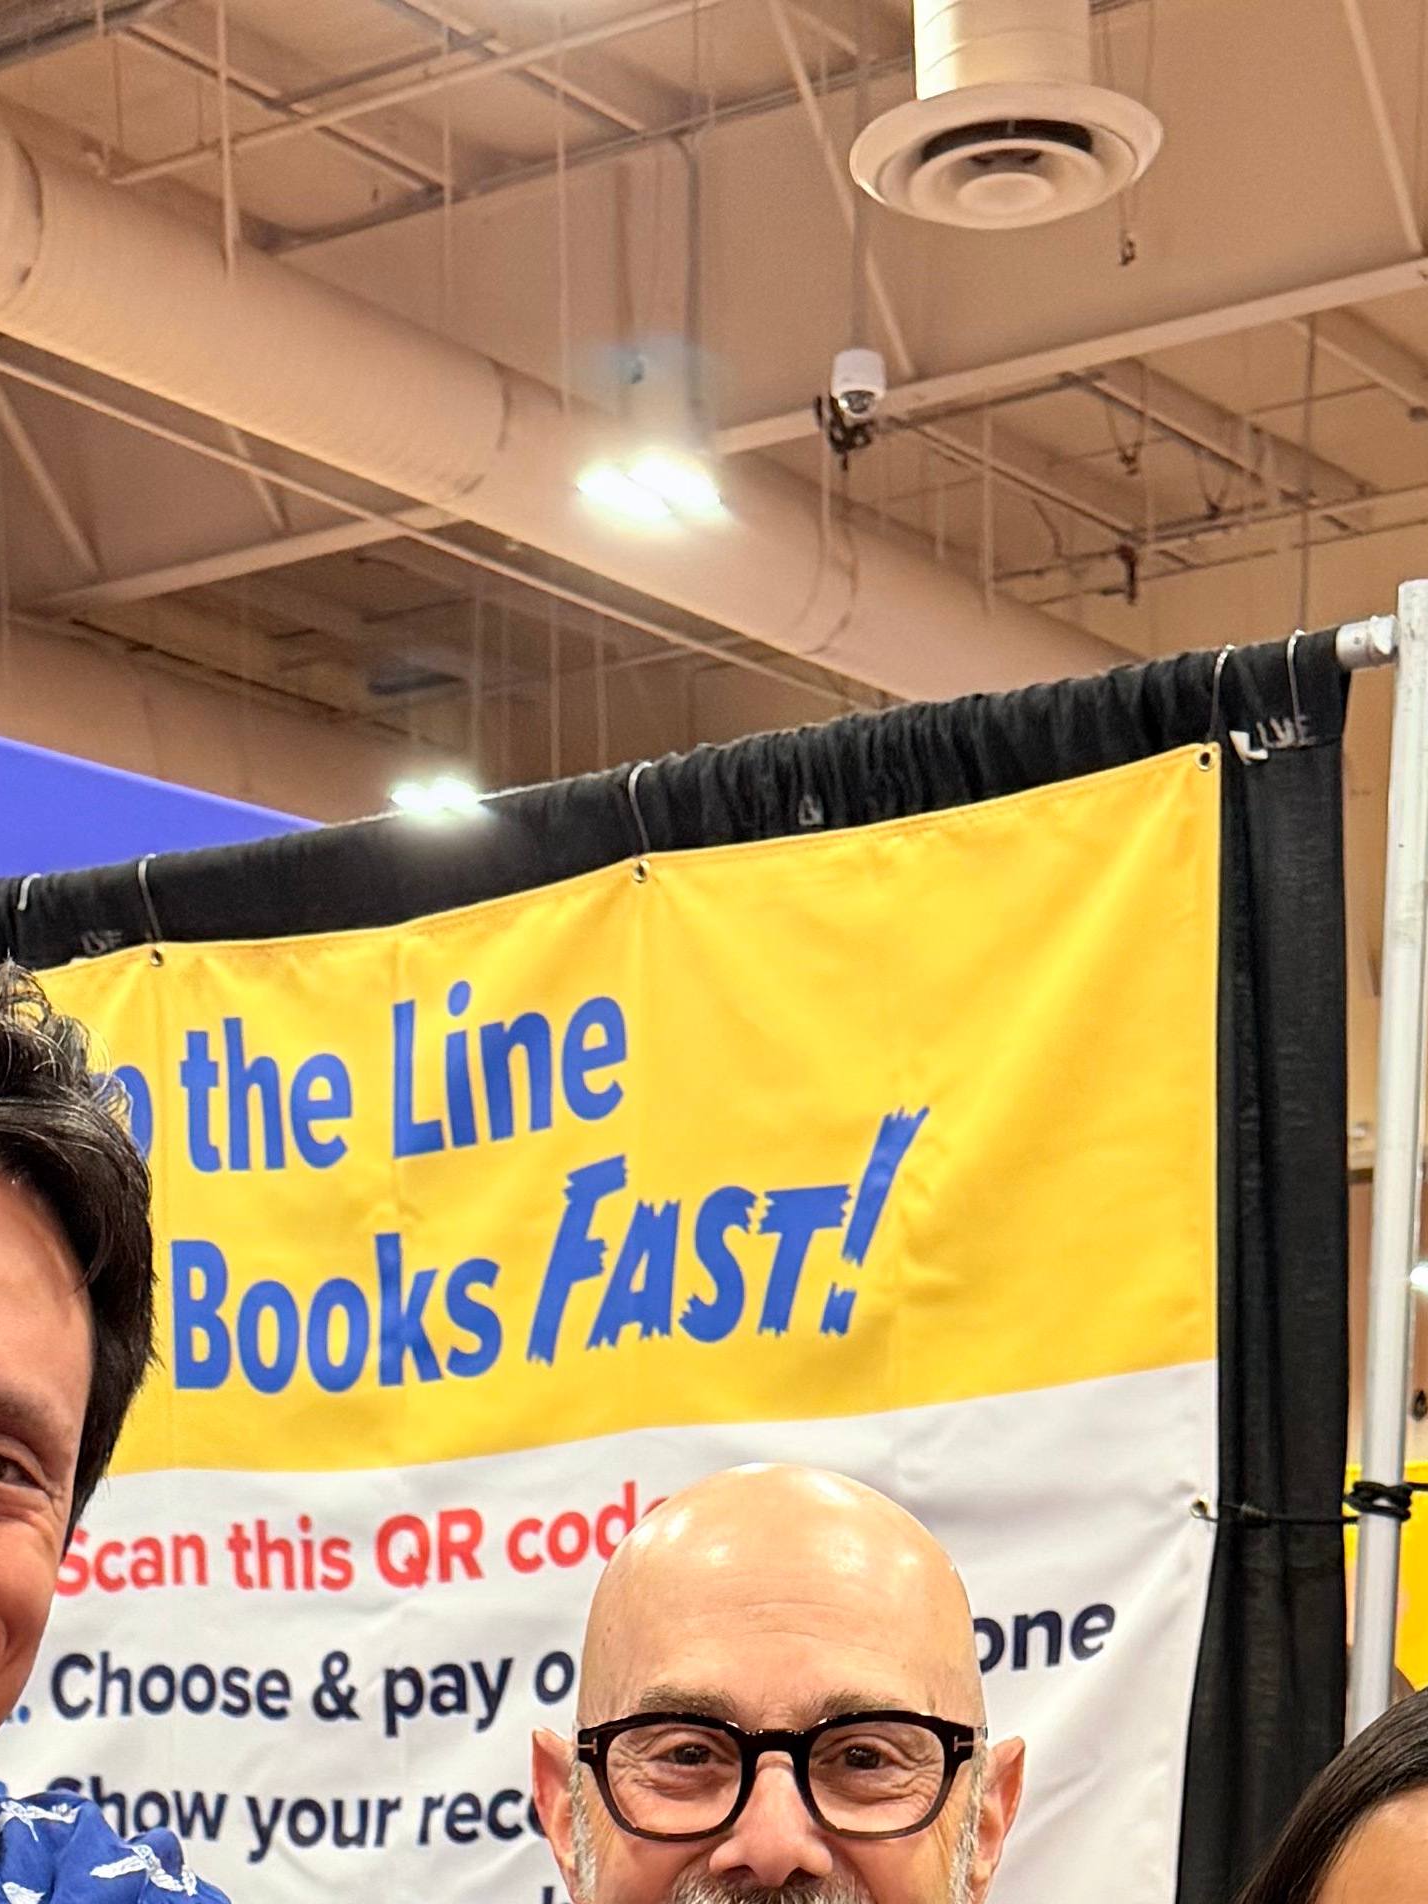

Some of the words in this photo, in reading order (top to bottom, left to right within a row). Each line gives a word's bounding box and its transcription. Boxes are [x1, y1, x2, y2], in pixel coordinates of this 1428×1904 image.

[179, 1016, 353, 1174] the
[392, 980, 628, 1160] Line
[170, 1231, 502, 1394] Books
[525, 1105, 931, 1367] FAST!
[55, 1526, 209, 1597] Scan
[228, 1515, 355, 1593] this
[376, 1507, 485, 1590] QR
[506, 1480, 669, 1574] cod
[50, 1650, 293, 1721] Choose
[311, 1650, 362, 1722] &
[383, 1650, 514, 1737] pay
[533, 1650, 576, 1705] o
[973, 1603, 1116, 1676] one
[46, 1776, 228, 1841] how
[247, 1795, 410, 1863] your
